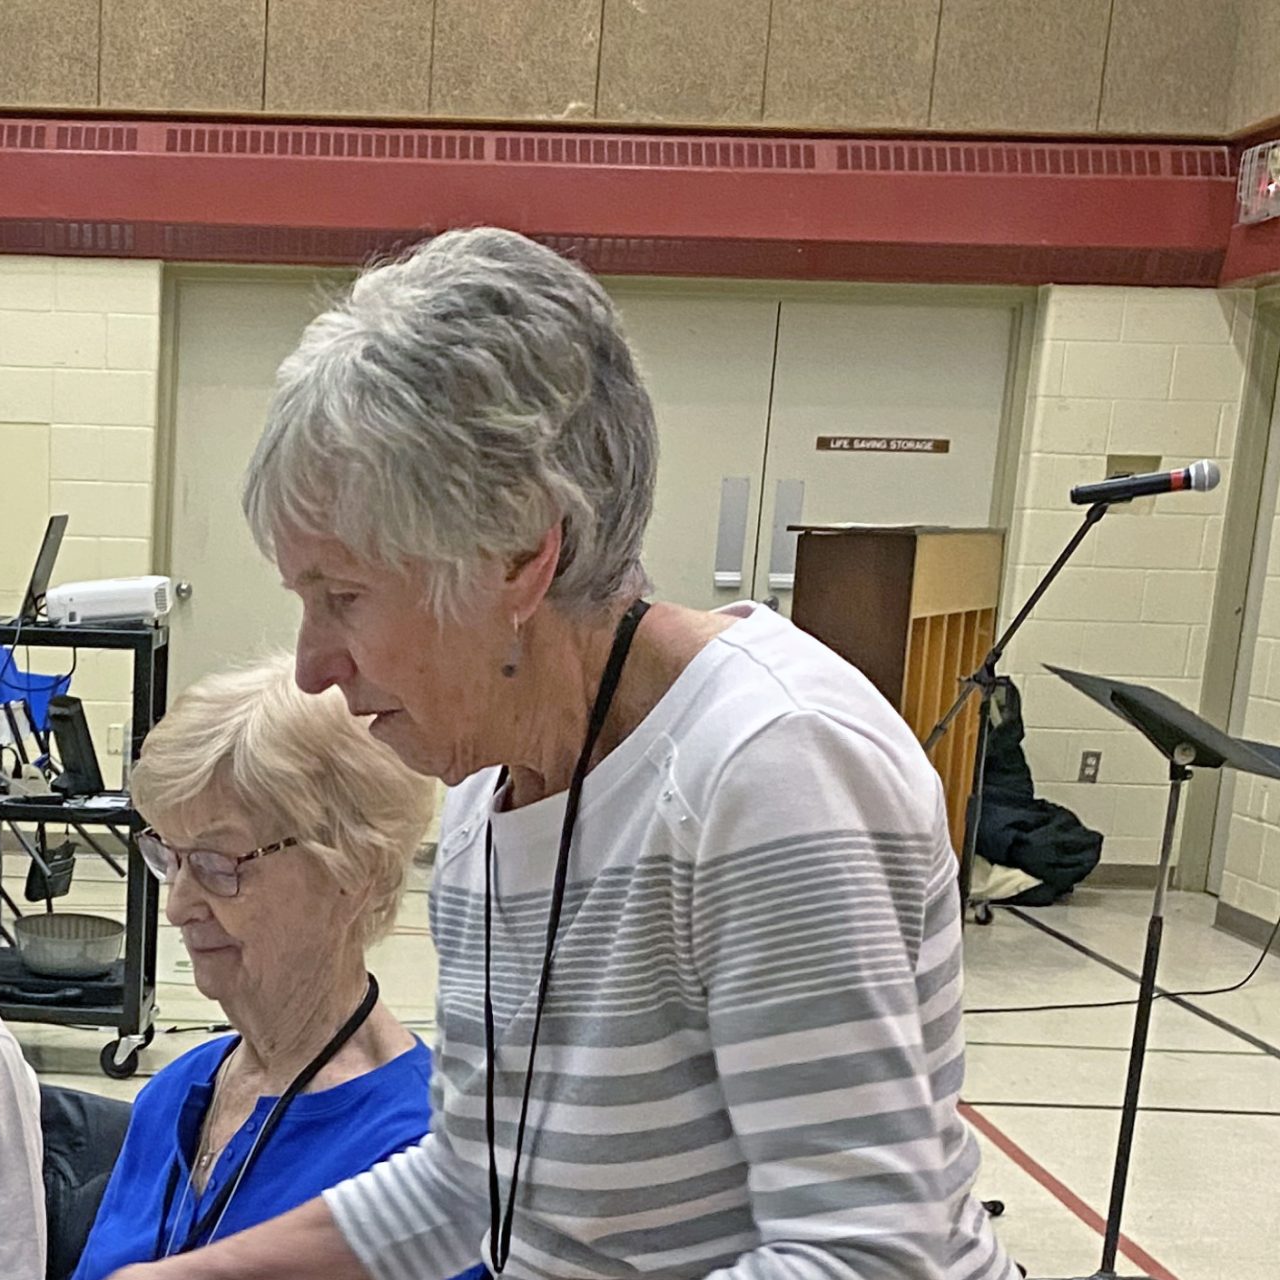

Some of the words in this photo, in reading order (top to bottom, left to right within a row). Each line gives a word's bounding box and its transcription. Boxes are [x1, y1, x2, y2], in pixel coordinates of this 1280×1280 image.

[830, 438, 850, 449] LIFE
[853, 439, 887, 449] SAVING
[890, 440, 934, 450] STORAGE
